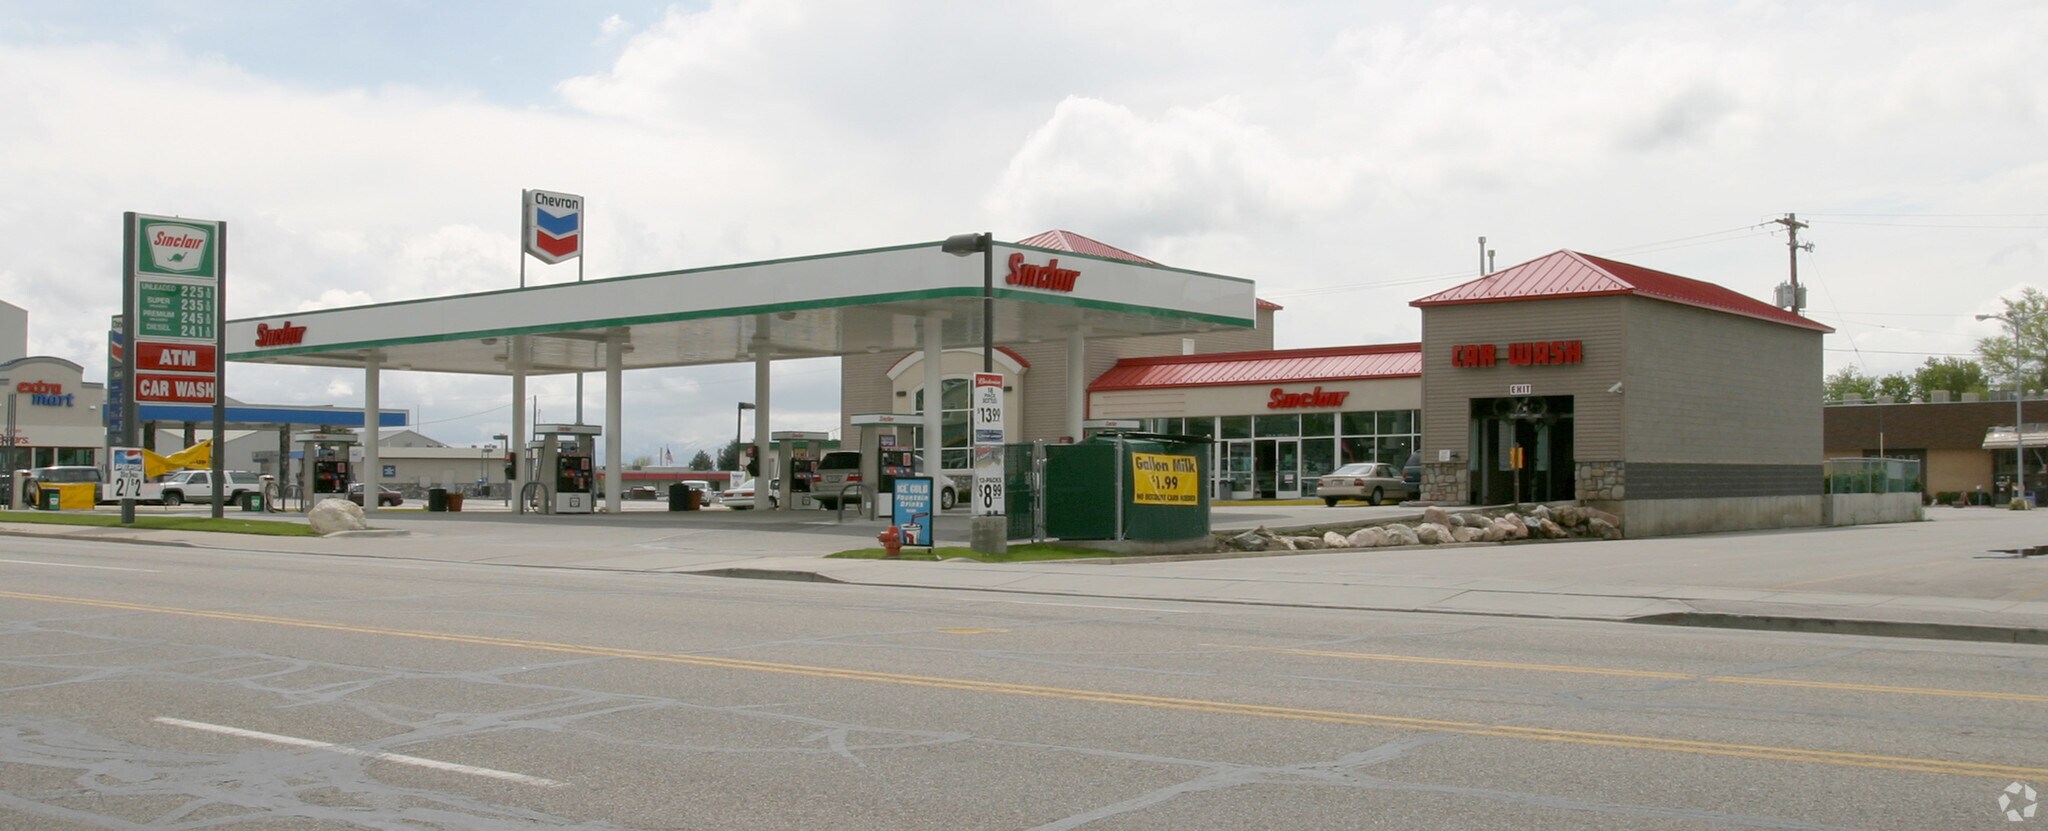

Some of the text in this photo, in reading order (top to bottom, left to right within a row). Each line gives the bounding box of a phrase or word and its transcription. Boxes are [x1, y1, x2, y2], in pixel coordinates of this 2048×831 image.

[535, 192, 579, 210] Chevron
[154, 231, 204, 250] Sinclair
[1005, 252, 1081, 293] Sinclair
[141, 283, 204, 298] UNLEADED 225
[146, 296, 204, 311] SUPER 235
[181, 312, 204, 325] 245
[181, 325, 203, 337] 241
[255, 321, 308, 347] Sinclair
[158, 348, 197, 367] ATM
[1451, 340, 1584, 368] CAR WASH
[17, 380, 63, 395] extra
[139, 379, 215, 399] CAR WASH
[1511, 385, 1530, 394] EXIT
[31, 393, 75, 408] mart
[1267, 386, 1350, 410] Sinclair
[1135, 456, 1196, 473] Gallon Milk
[1151, 475, 1178, 490] $1.99
